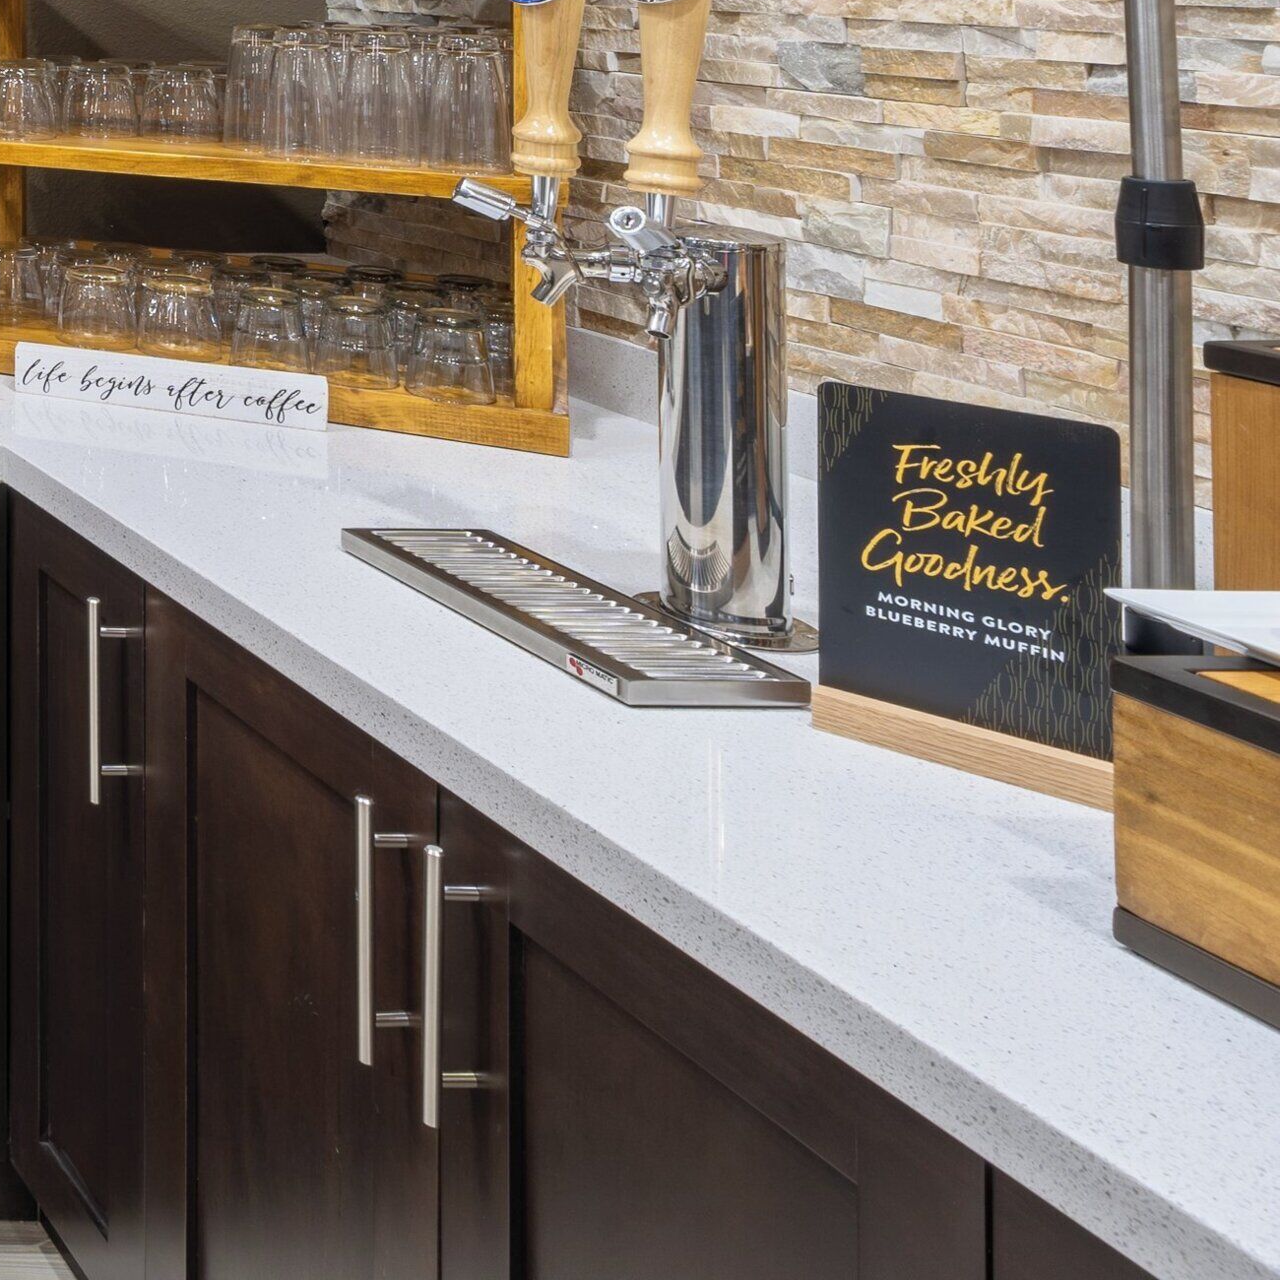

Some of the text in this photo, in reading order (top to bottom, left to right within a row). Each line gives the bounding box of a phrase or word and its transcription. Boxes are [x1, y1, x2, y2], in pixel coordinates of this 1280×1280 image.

[22, 359, 322, 423] life begins after coffee
[892, 444, 1054, 506] Freshly
[892, 488, 1046, 547] Baked
[861, 528, 1070, 603] Goodness.
[866, 605, 1065, 663] BLUEBERRY MUFFIN
[878, 591, 1052, 641] MORNING GLORY
